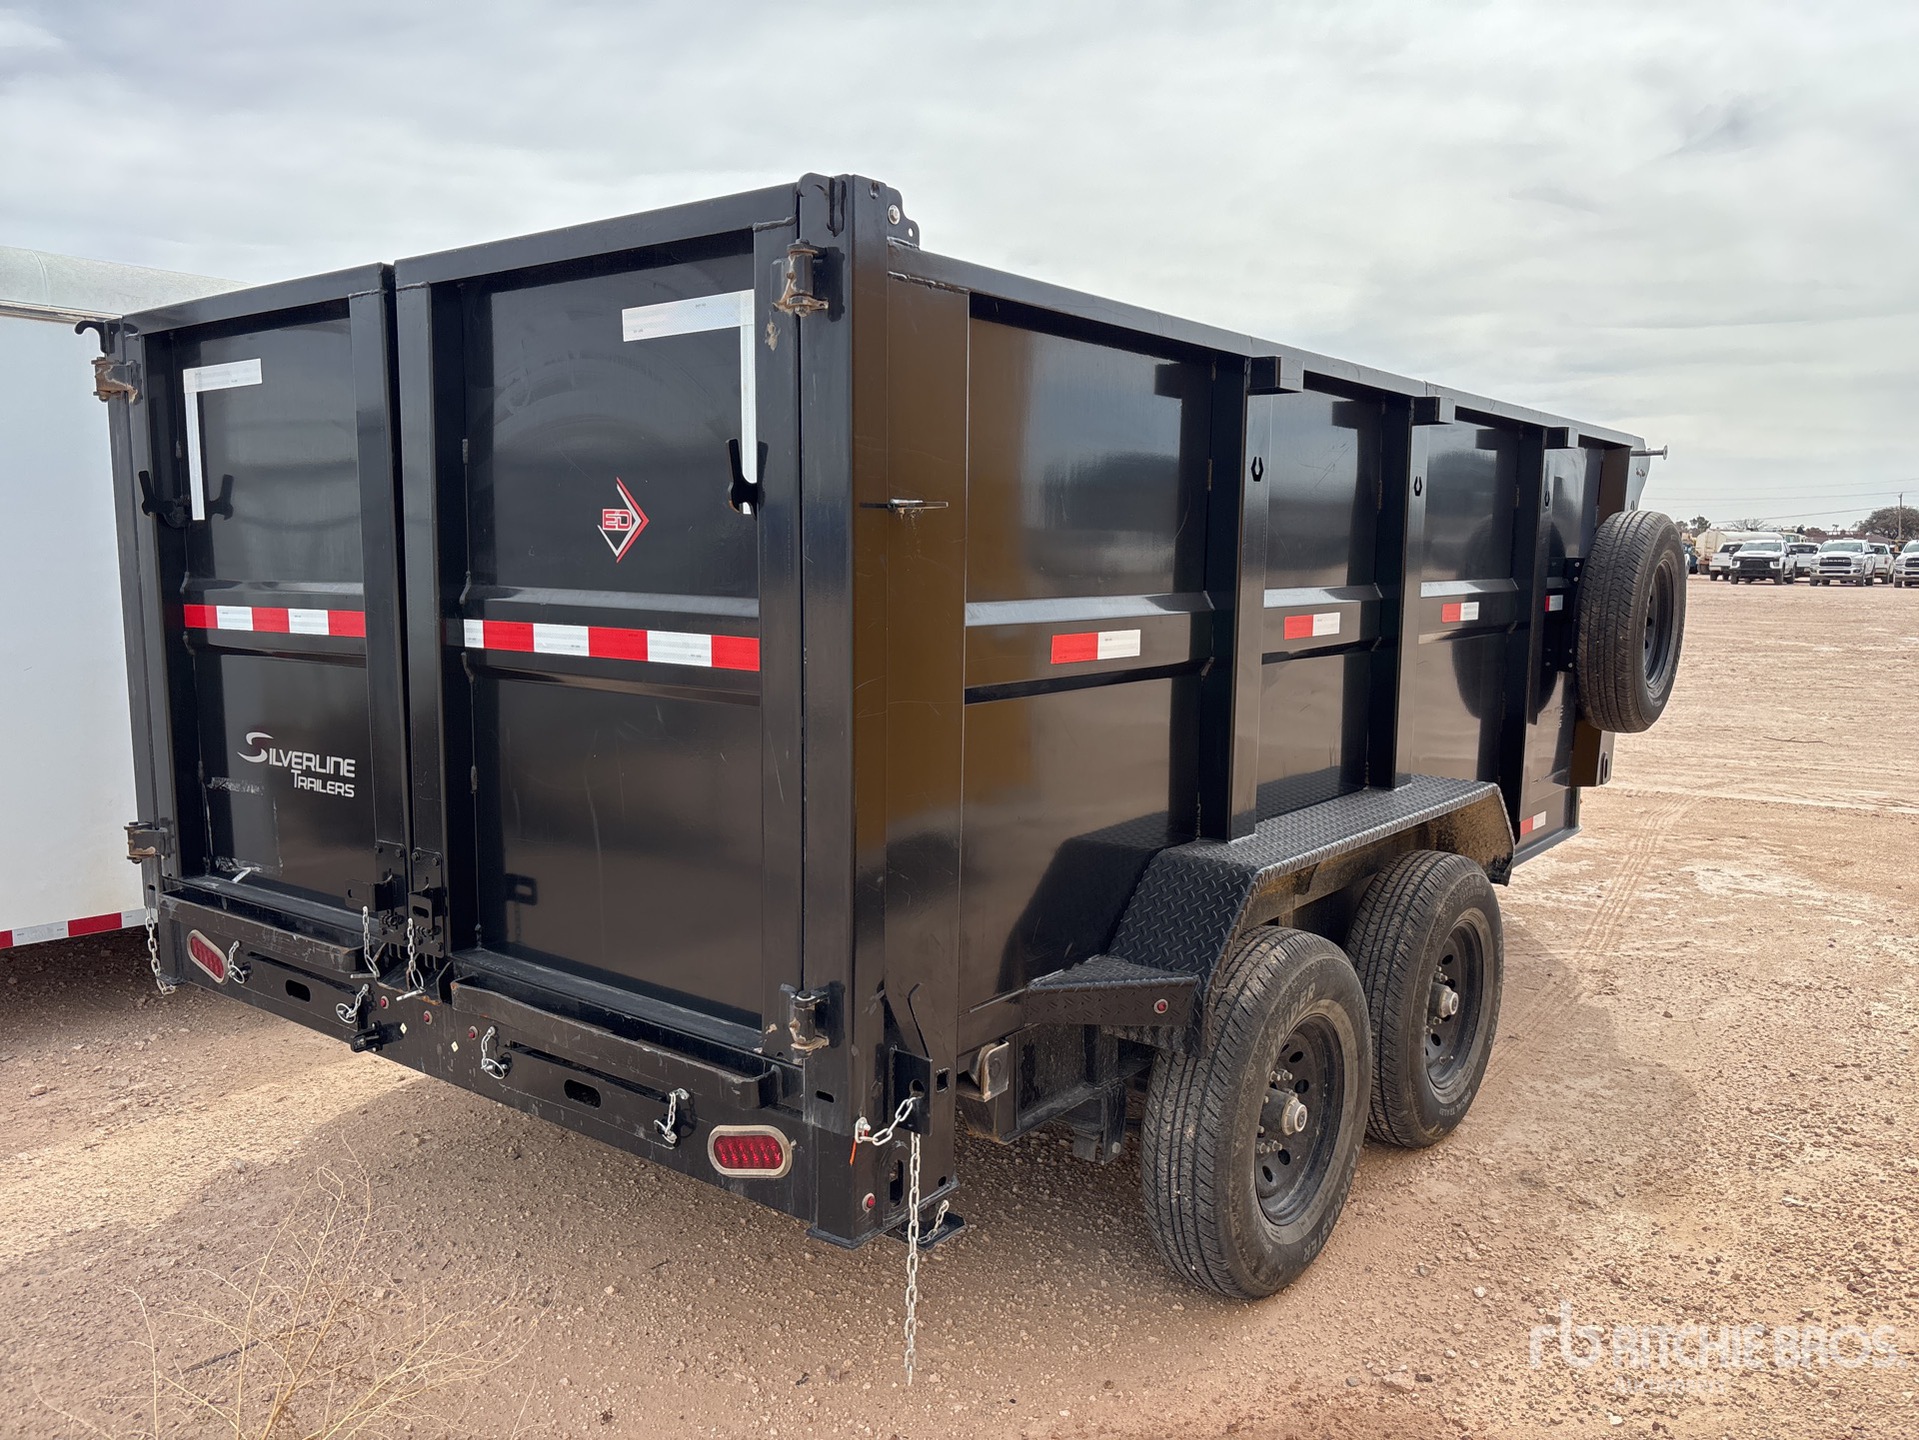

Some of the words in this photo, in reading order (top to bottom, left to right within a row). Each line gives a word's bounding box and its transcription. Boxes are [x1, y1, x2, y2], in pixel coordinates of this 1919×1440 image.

[602, 508, 633, 531] ED
[237, 731, 356, 778] SILVERLINE
[291, 769, 356, 798] TRAILERS
